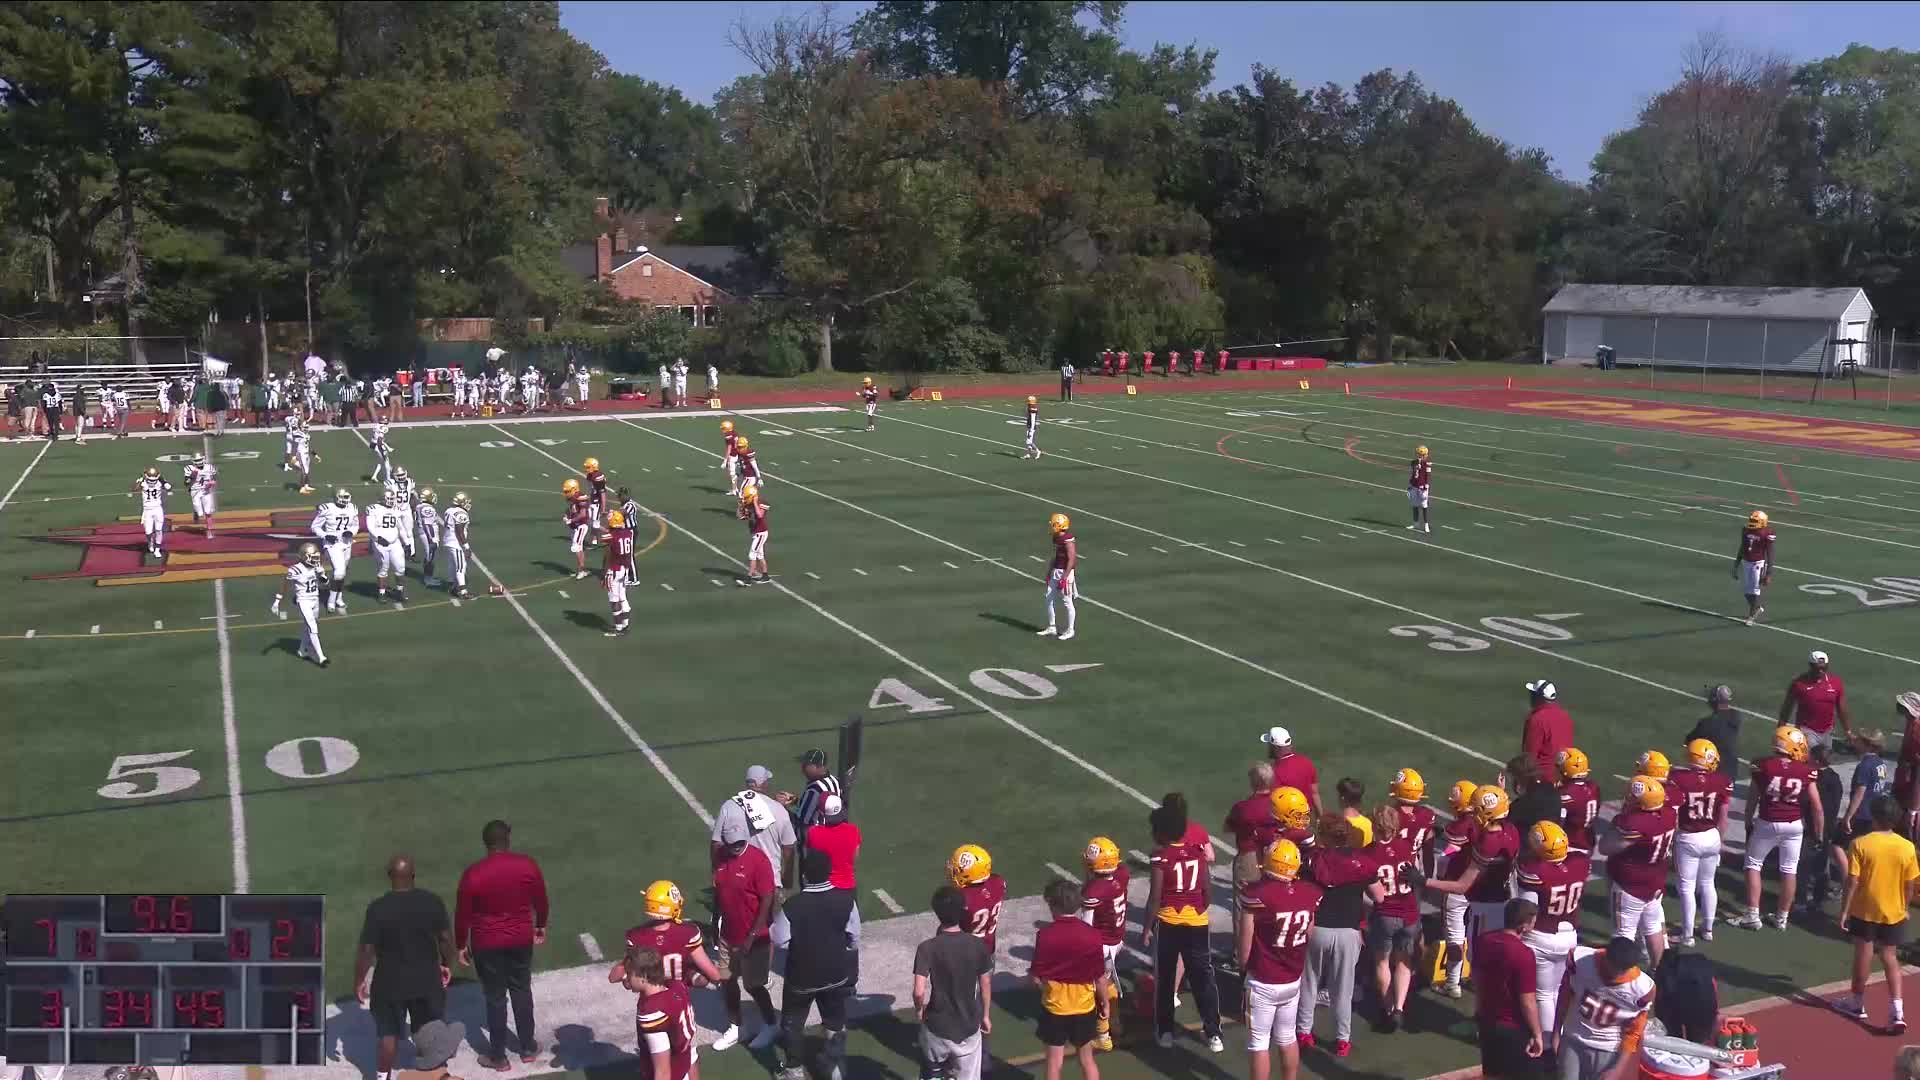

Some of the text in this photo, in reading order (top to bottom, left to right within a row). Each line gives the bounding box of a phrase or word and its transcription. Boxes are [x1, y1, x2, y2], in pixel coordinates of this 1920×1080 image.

[396, 490, 409, 503] 53
[335, 516, 350, 531] 77
[381, 516, 397, 529] 59
[618, 537, 631, 555] 16
[1388, 616, 1574, 652] 30
[868, 667, 1059, 713] 40
[96, 736, 361, 799] 50
[1766, 775, 1804, 804] 42
[1687, 791, 1718, 820] 51
[1172, 859, 1200, 893] 17
[1547, 880, 1585, 917] 50
[1272, 909, 1312, 948] 72
[1733, 1053, 1745, 1065] G
